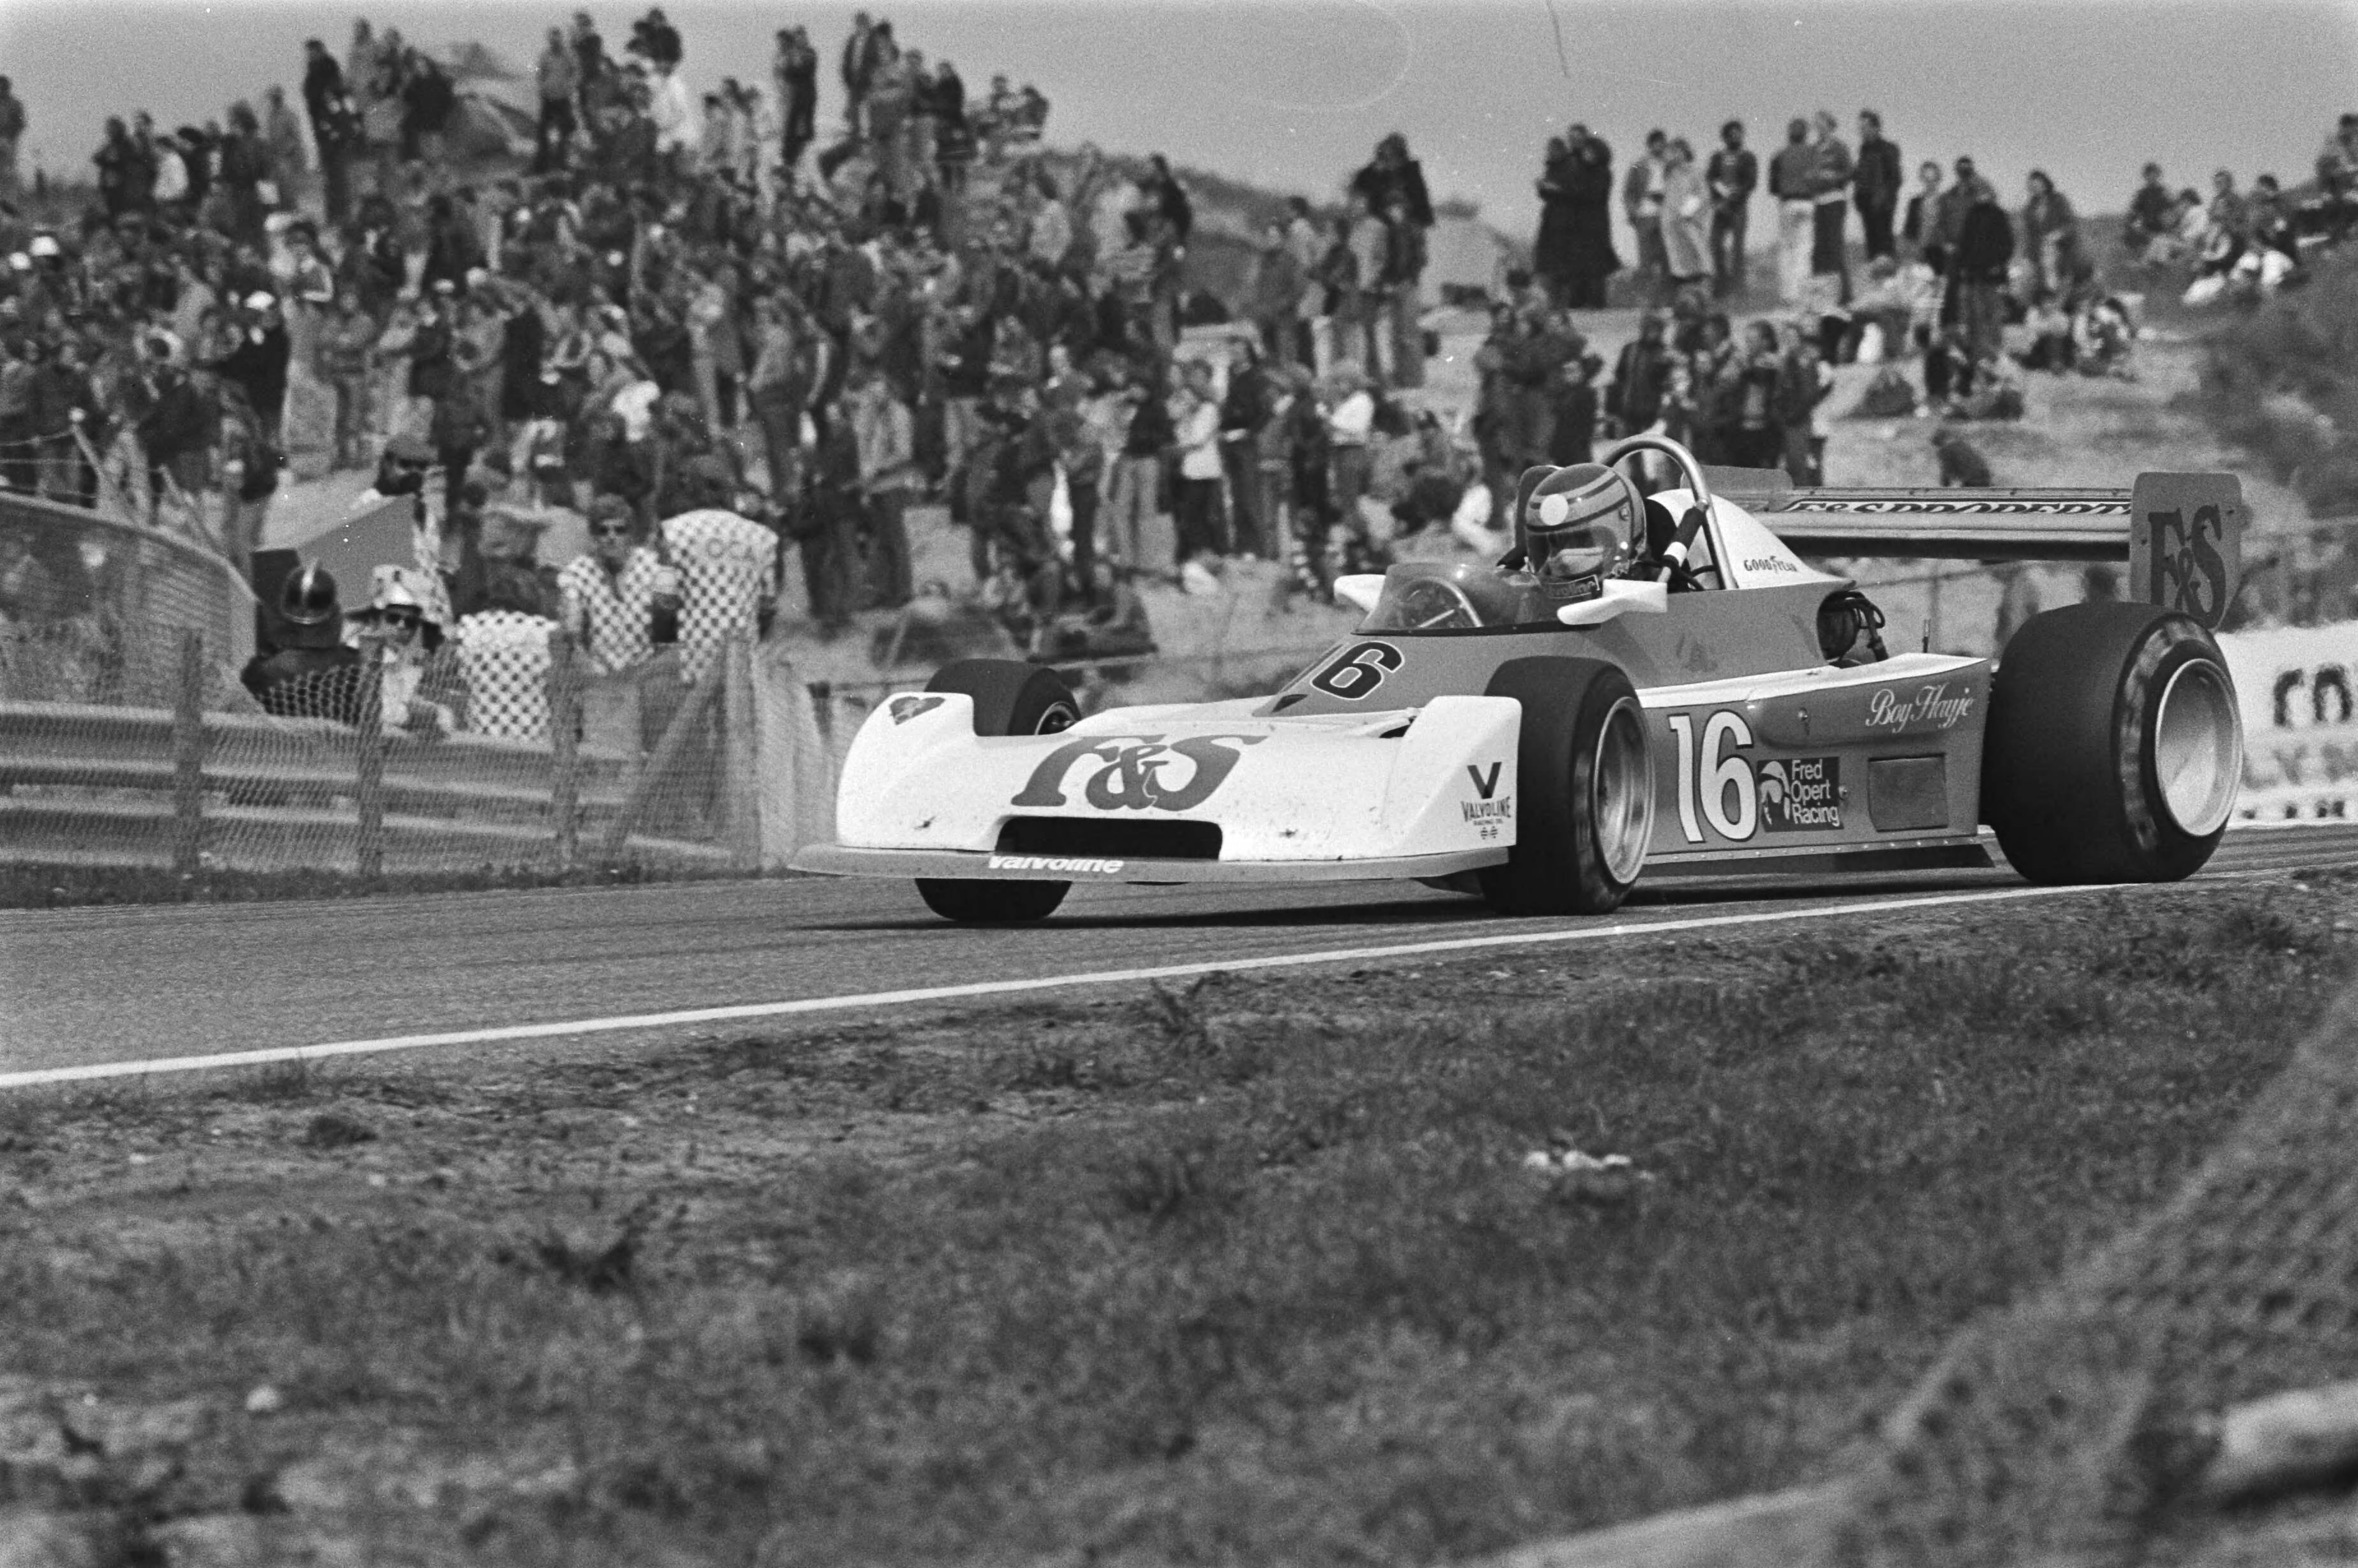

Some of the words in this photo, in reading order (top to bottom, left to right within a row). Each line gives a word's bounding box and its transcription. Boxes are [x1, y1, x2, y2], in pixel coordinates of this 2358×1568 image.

[2147, 503, 2227, 629] F&S
[1865, 688, 1913, 734] Boy
[1910, 682, 1974, 729] Hayje
[1468, 761, 1502, 799] V
[1667, 708, 1758, 844] 16
[1791, 758, 1823, 780] Fred
[1791, 779, 1831, 805] Opert
[1460, 795, 1512, 822] VALVOLINE
[1791, 802, 1840, 827] Racing
